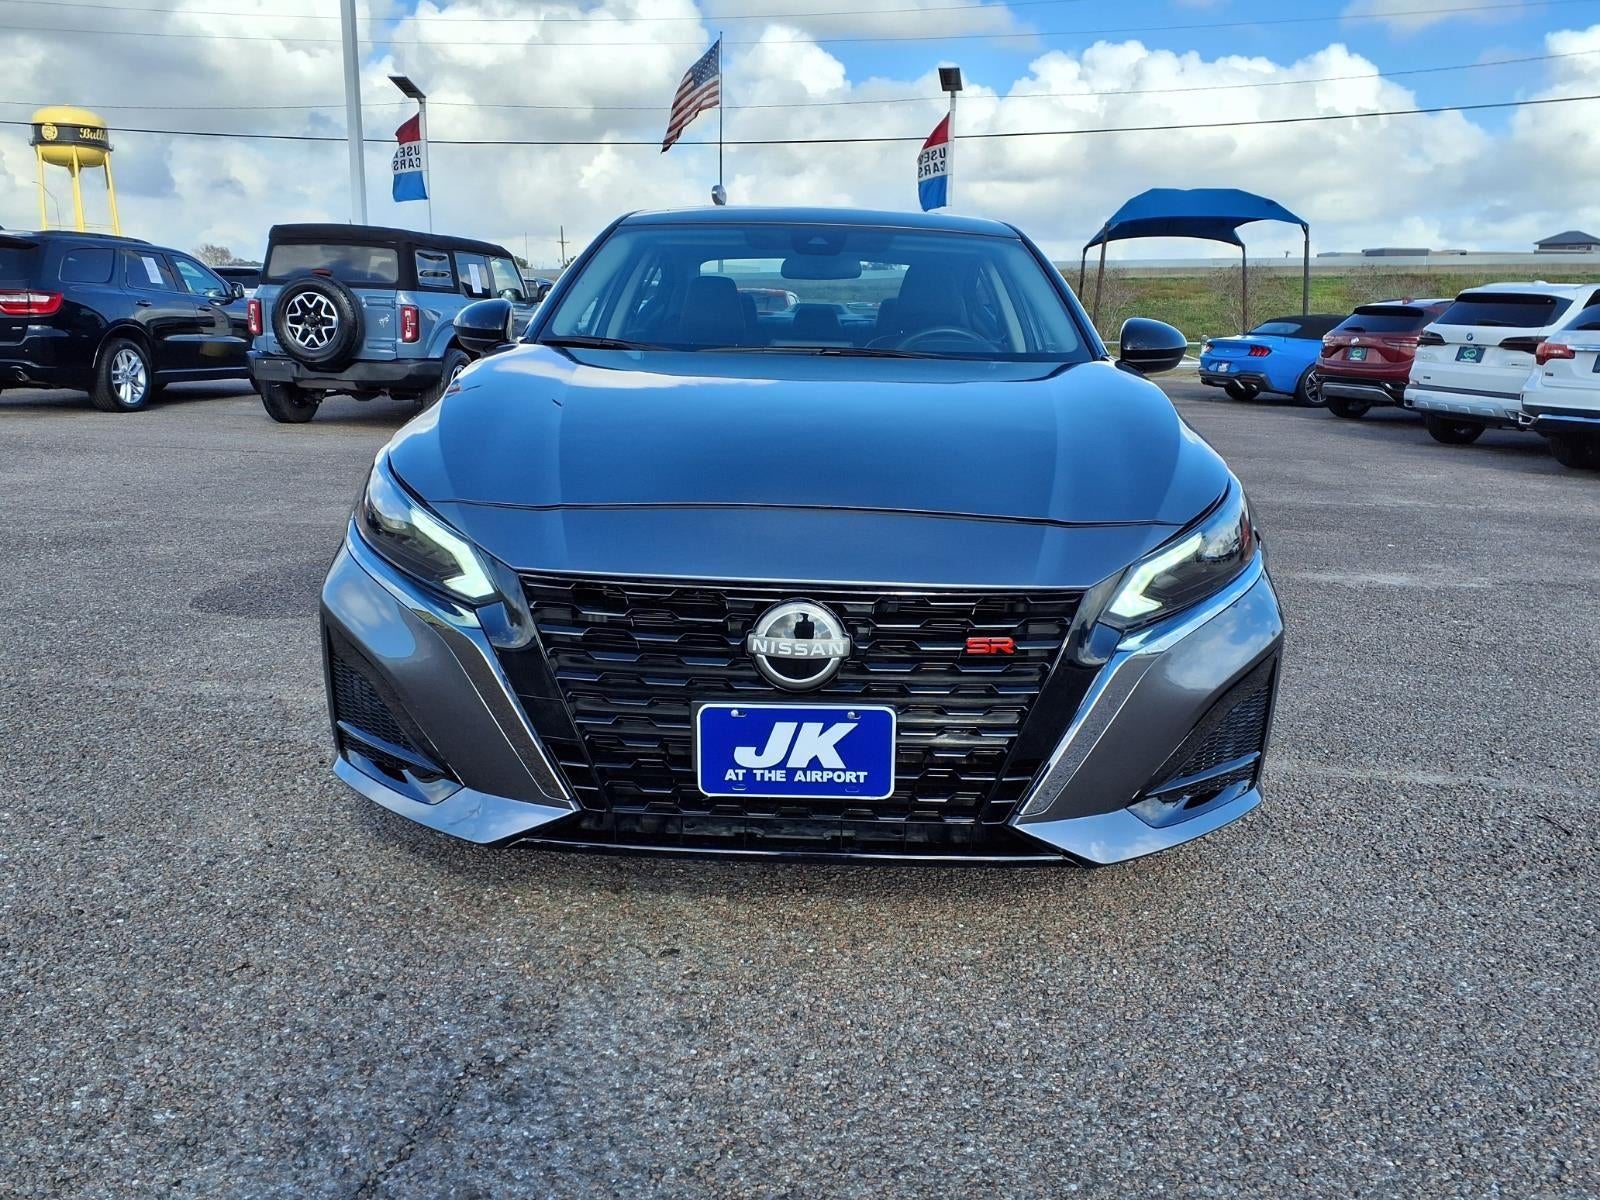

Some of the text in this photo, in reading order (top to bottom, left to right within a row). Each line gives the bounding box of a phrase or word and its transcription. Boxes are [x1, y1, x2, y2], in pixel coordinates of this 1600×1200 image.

[752, 638, 844, 657] NISSAN
[966, 636, 1015, 654] SR
[733, 721, 859, 769] JK
[724, 769, 868, 783] AT THE AIRPORT
